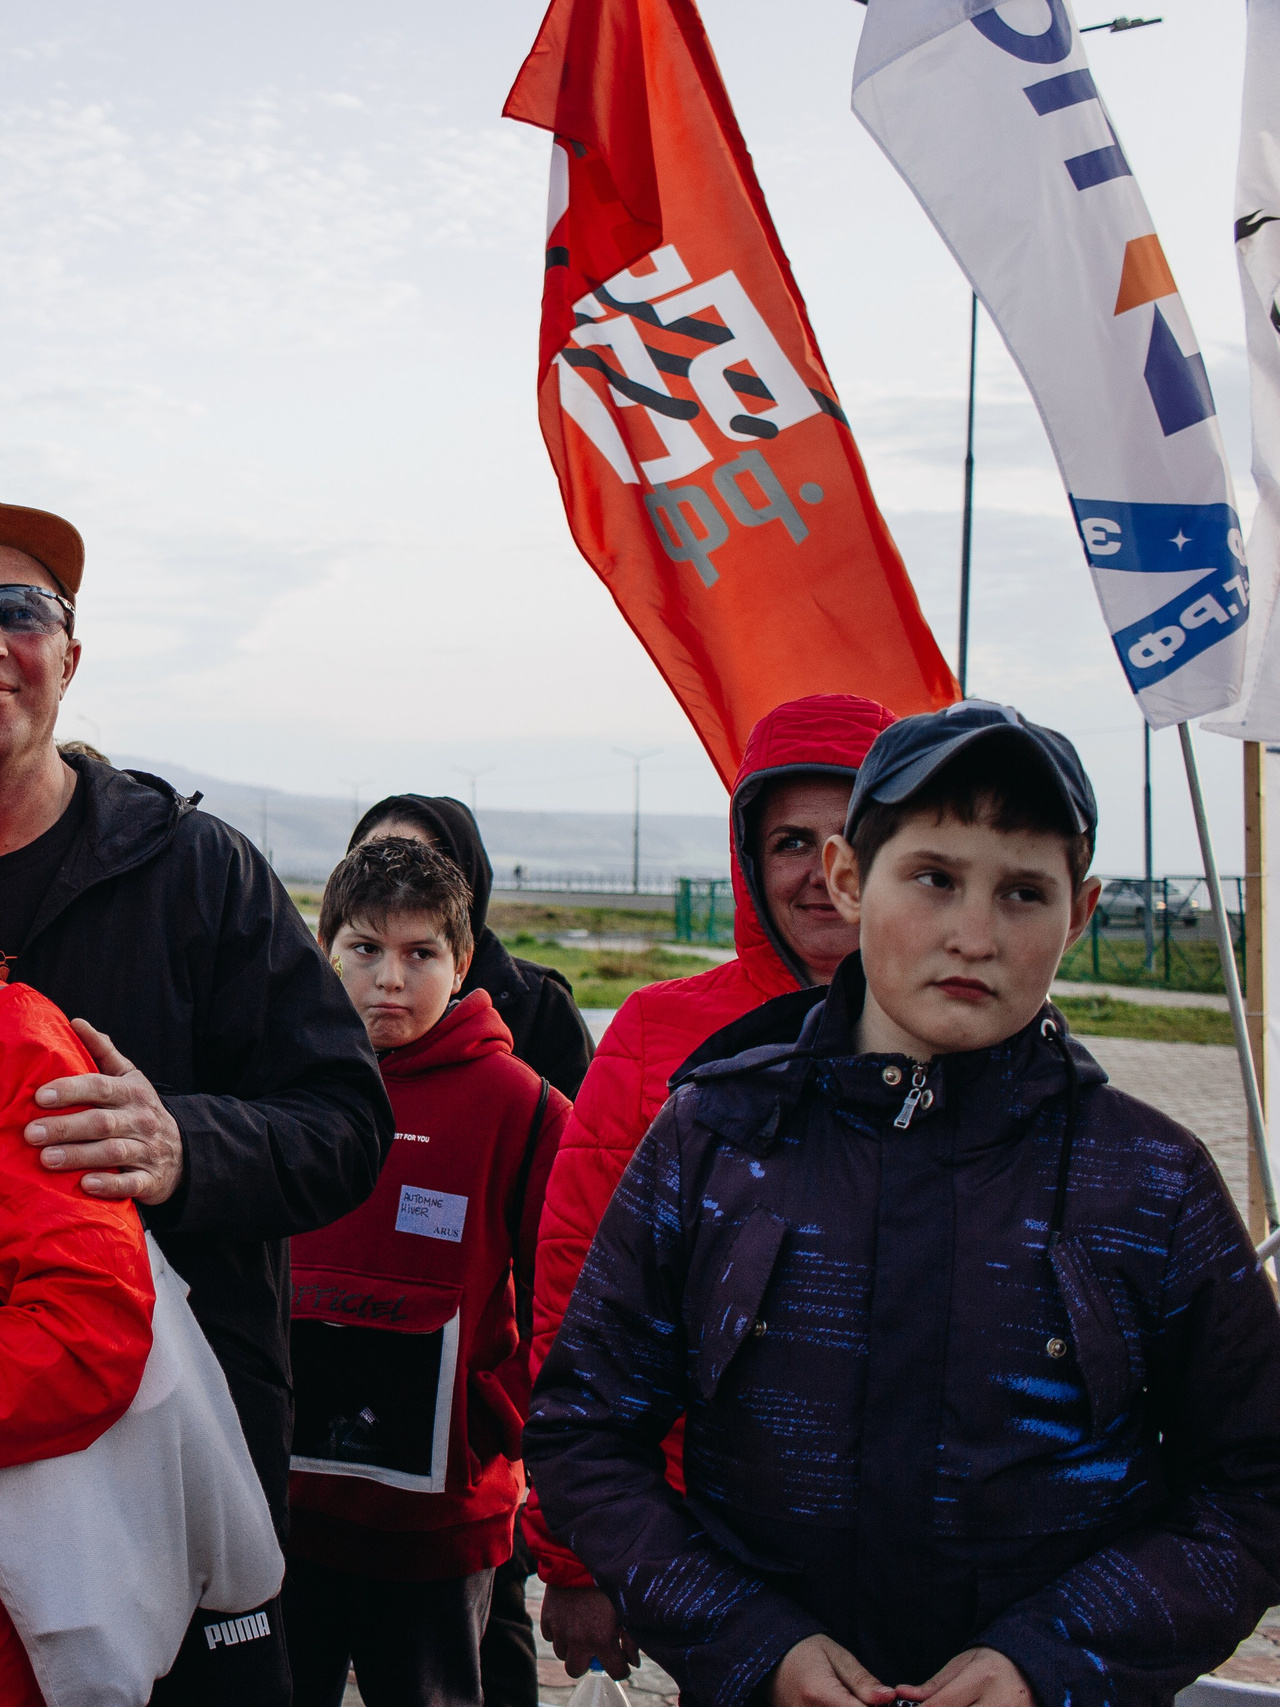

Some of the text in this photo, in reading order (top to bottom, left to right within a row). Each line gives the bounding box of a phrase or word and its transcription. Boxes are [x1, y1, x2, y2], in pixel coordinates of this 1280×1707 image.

[403, 1133, 417, 1141] FOR
[417, 1135, 430, 1143] YOU
[403, 1192, 444, 1209] AUTOMNE
[433, 1226, 459, 1238] ARUS
[204, 1612, 271, 1649] PUMA
